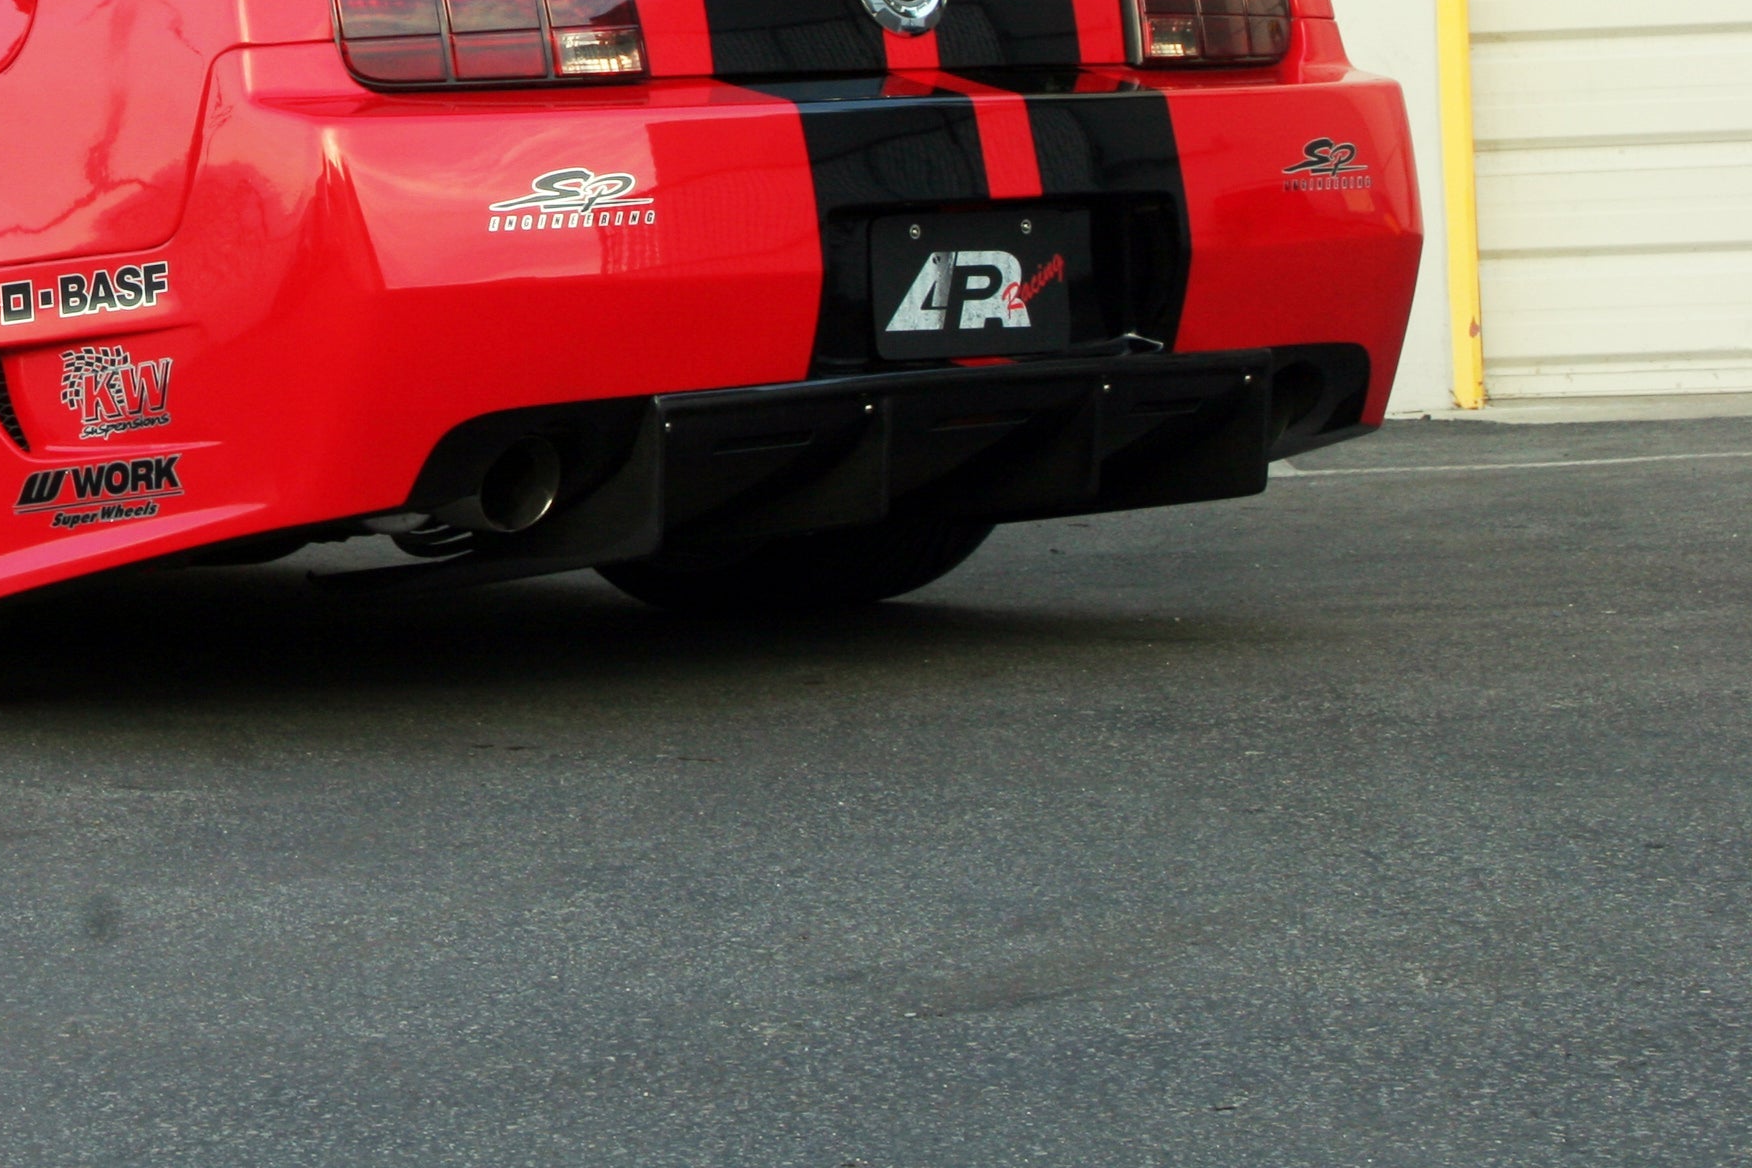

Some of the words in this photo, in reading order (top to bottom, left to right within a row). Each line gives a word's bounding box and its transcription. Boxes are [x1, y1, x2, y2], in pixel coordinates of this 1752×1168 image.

[489, 211, 655, 231] ENGINEERING
[58, 261, 168, 318] BASF
[885, 250, 1031, 331] APR
[1002, 253, 1065, 319] Racing
[81, 358, 173, 423] KW
[69, 454, 182, 500] WORK
[51, 511, 98, 528] Super
[99, 500, 159, 521] Wheels
